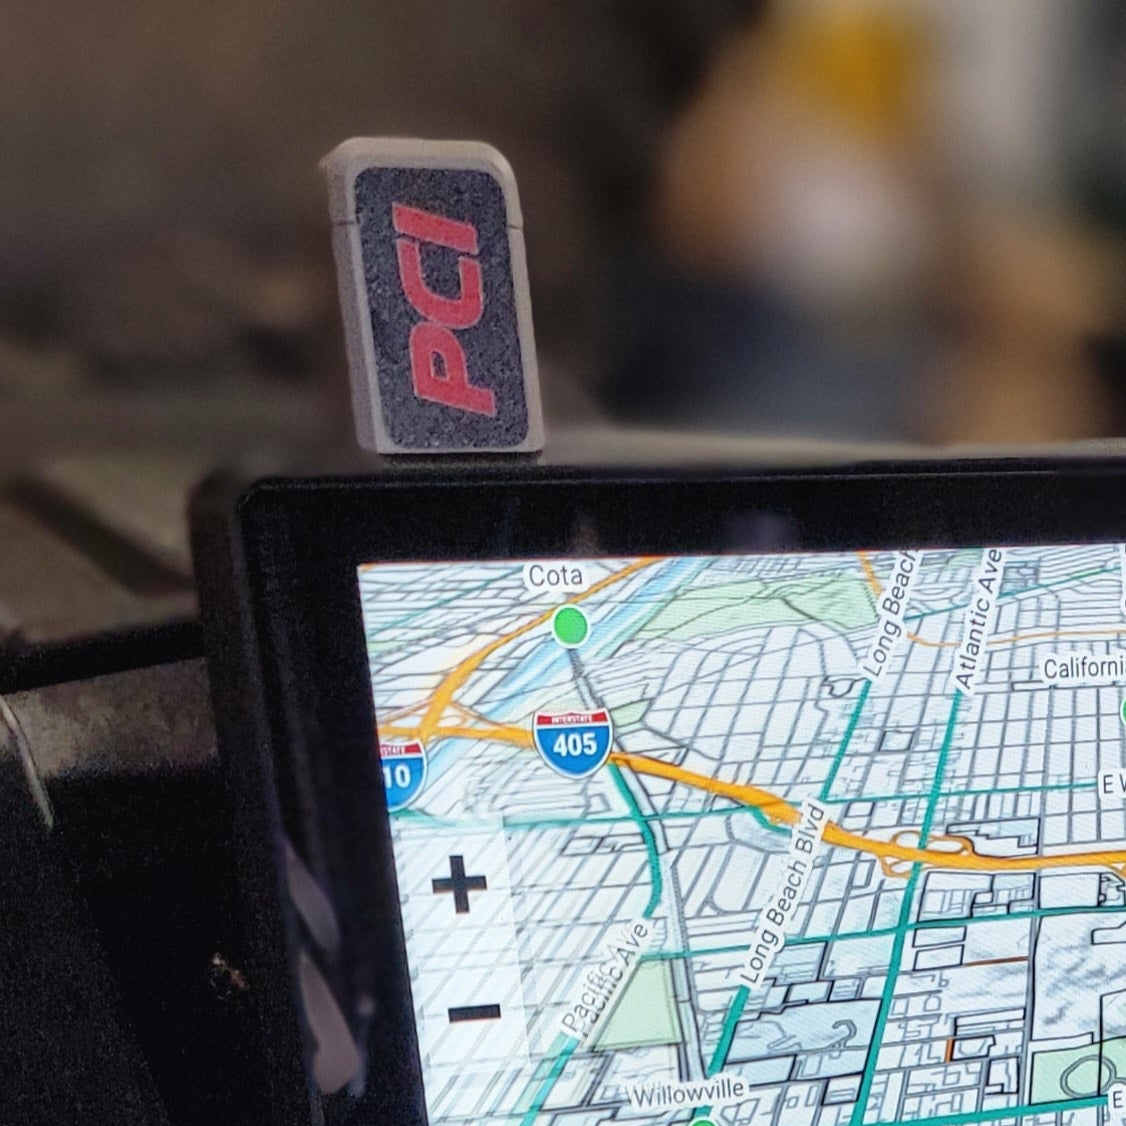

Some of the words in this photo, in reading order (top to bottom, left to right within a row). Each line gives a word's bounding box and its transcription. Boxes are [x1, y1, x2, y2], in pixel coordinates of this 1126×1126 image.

[393, 202, 496, 416] PCI
[528, 565, 583, 587] Cota
[956, 598, 990, 690] Atlantic
[978, 549, 1003, 594] Ave
[862, 618, 901, 677] Long
[552, 731, 598, 757] 405
[1103, 774, 1114, 794] E
[740, 929, 779, 984] Long
[767, 860, 807, 926] Beach
[795, 804, 824, 854] Blvd
[616, 922, 648, 967] Ave
[625, 1077, 745, 1108] Willowville
[1112, 1090, 1122, 1109] E
